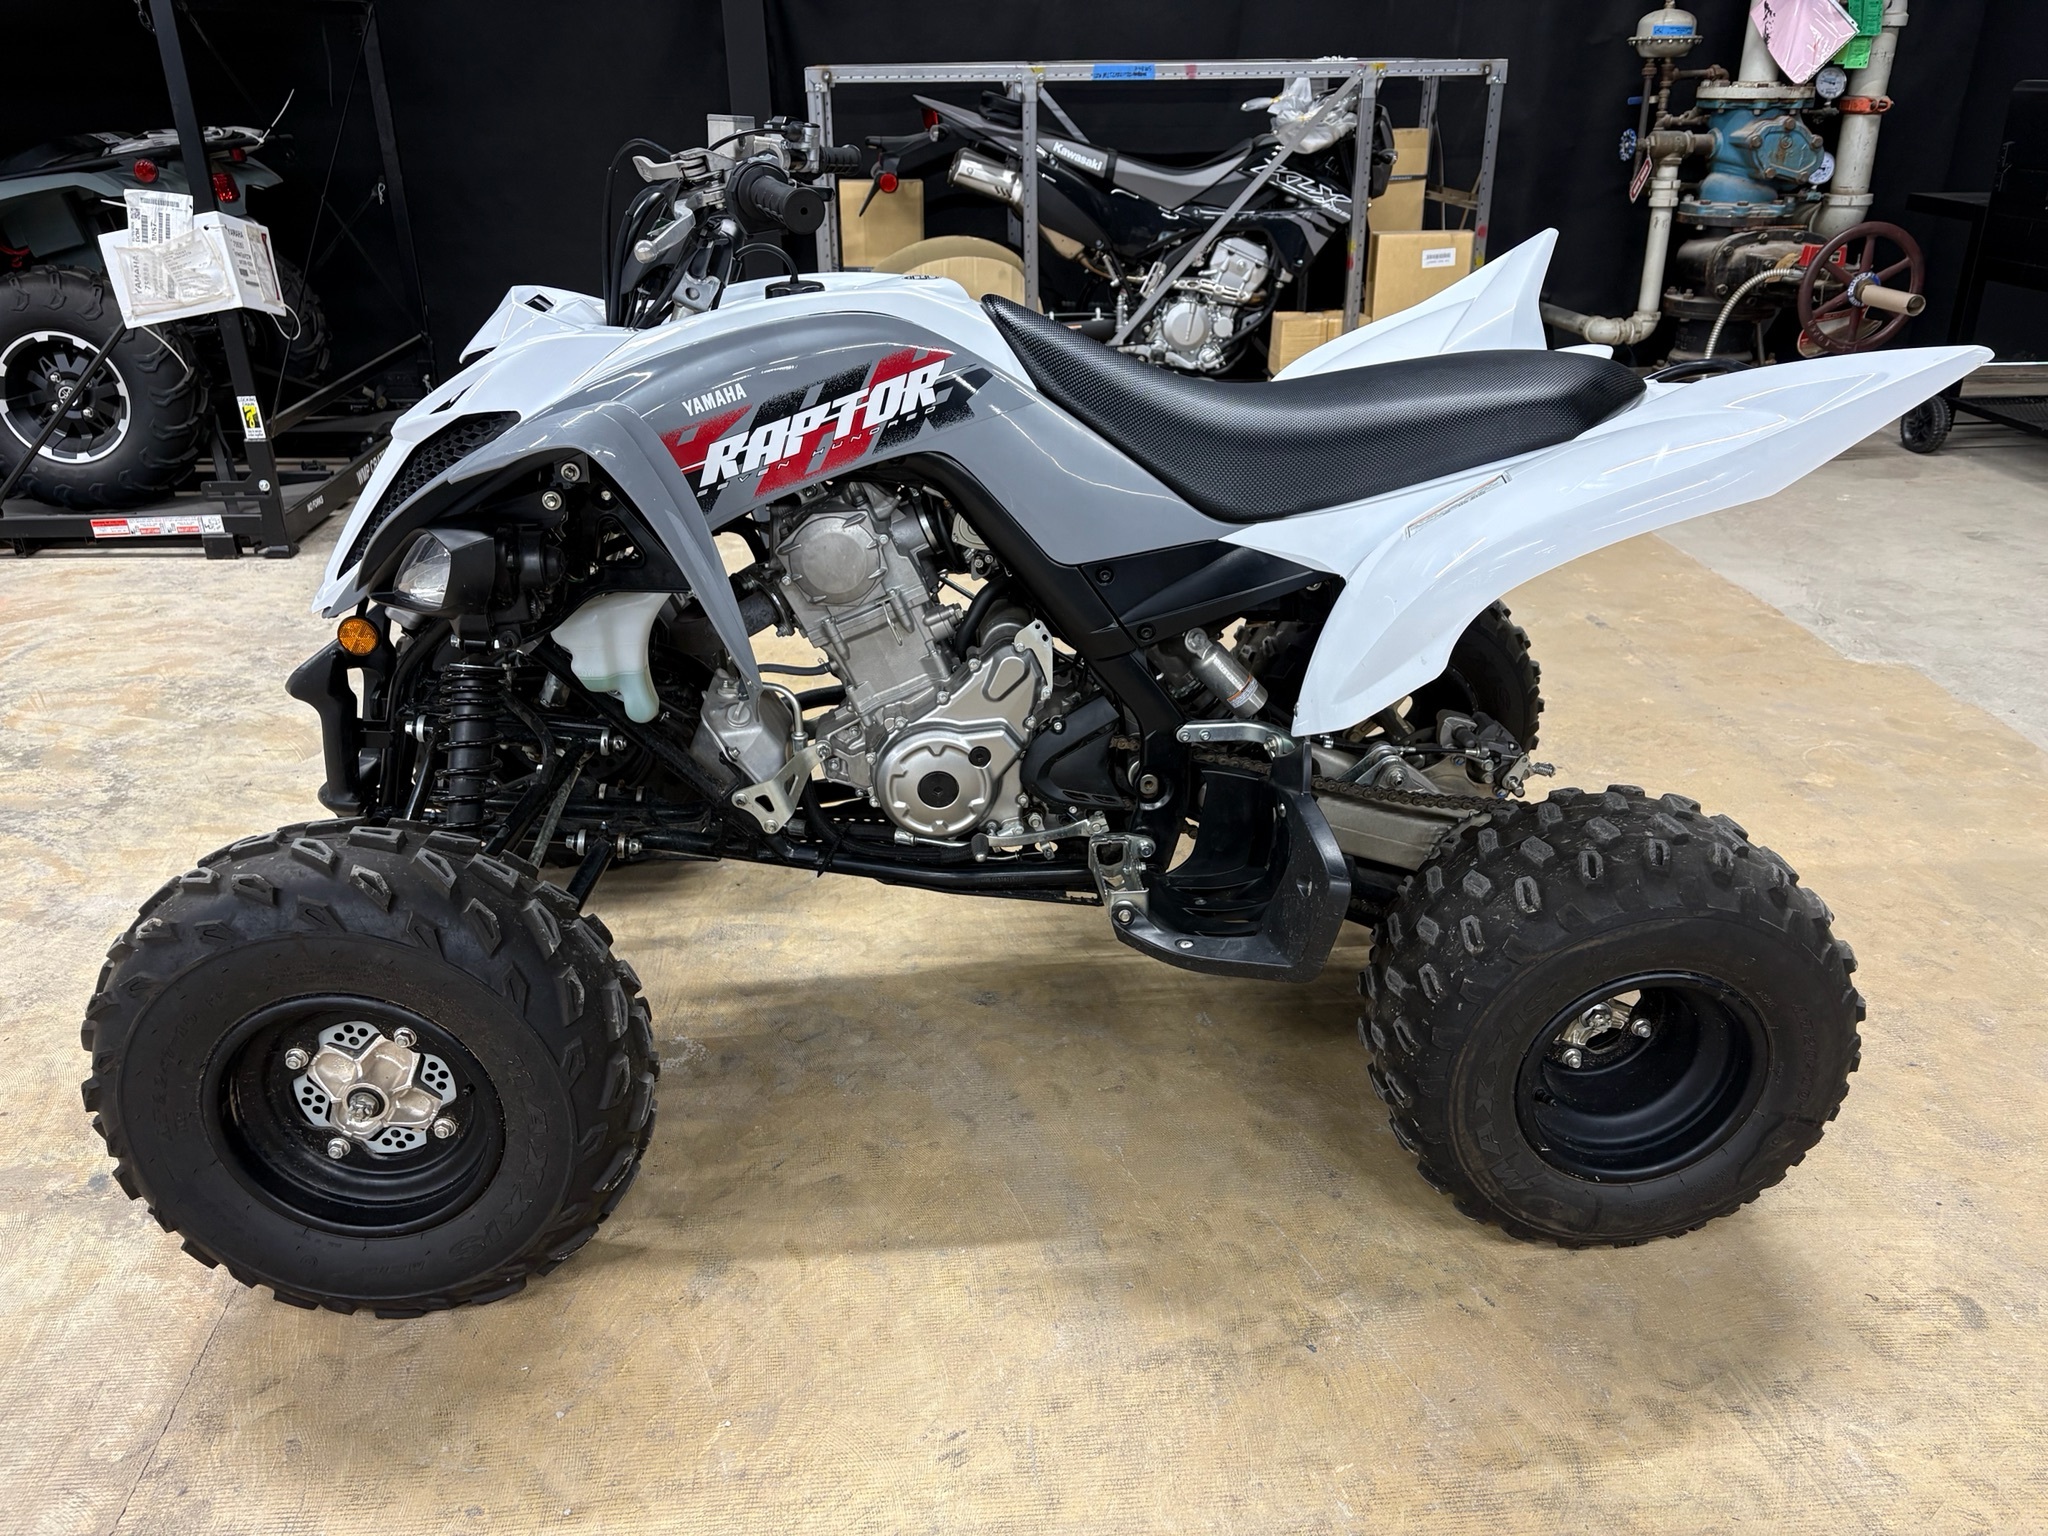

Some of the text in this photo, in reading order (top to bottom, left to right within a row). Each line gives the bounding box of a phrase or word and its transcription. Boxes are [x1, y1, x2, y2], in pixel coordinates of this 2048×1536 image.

[1052, 141, 1103, 171] Kawasaki
[132, 255, 142, 294] YAMAHA
[682, 382, 748, 417] YAMAHA
[699, 359, 946, 488] RAPTOR
[1473, 980, 1559, 1192] MAXXIS
[449, 1053, 550, 1262] MAXXIS
